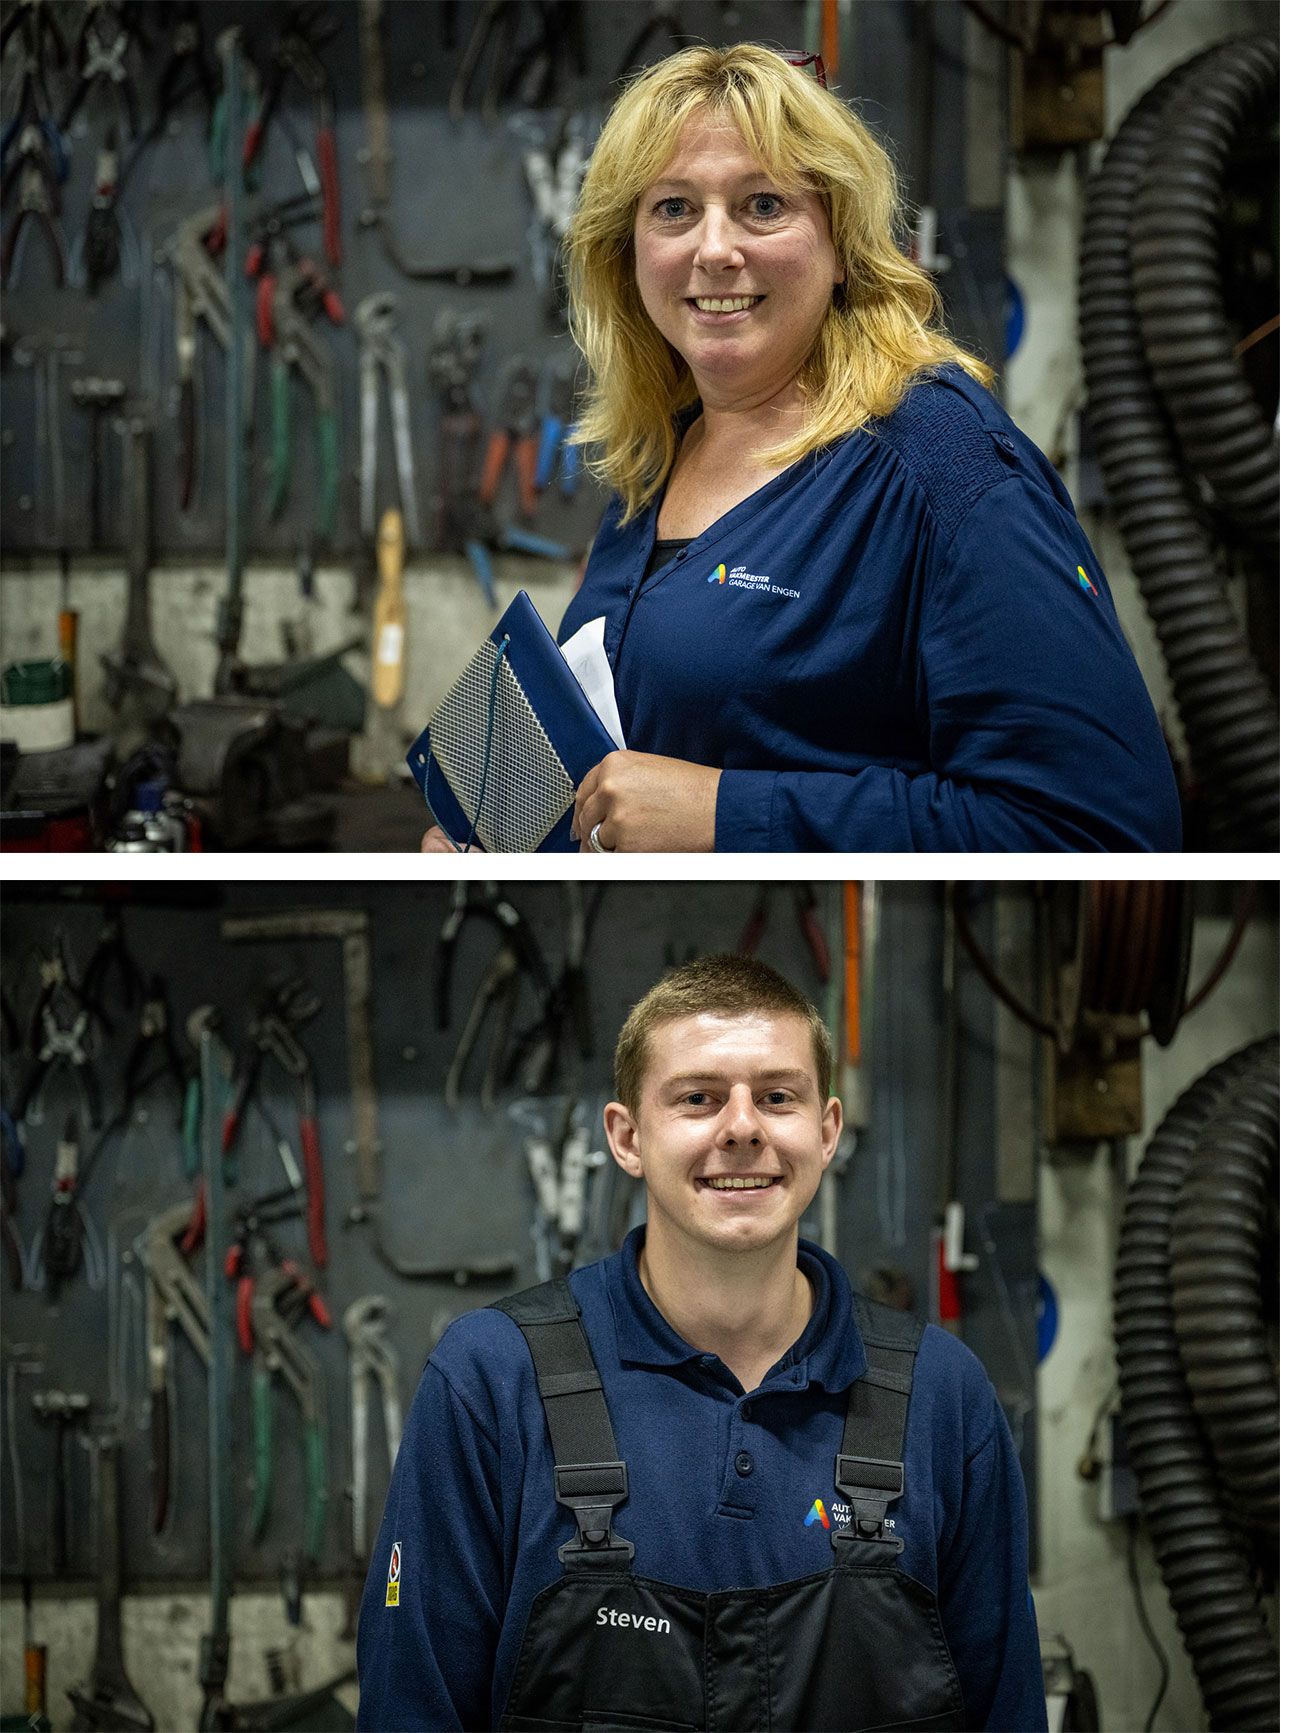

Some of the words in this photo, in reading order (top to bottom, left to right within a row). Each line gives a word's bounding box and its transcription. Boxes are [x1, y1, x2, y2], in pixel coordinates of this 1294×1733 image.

[728, 579, 755, 590] GARAGE
[755, 583, 771, 592] VAN
[771, 585, 801, 598] ENGEN
[831, 1503, 850, 1513] AUT
[596, 1607, 671, 1634] Steven
